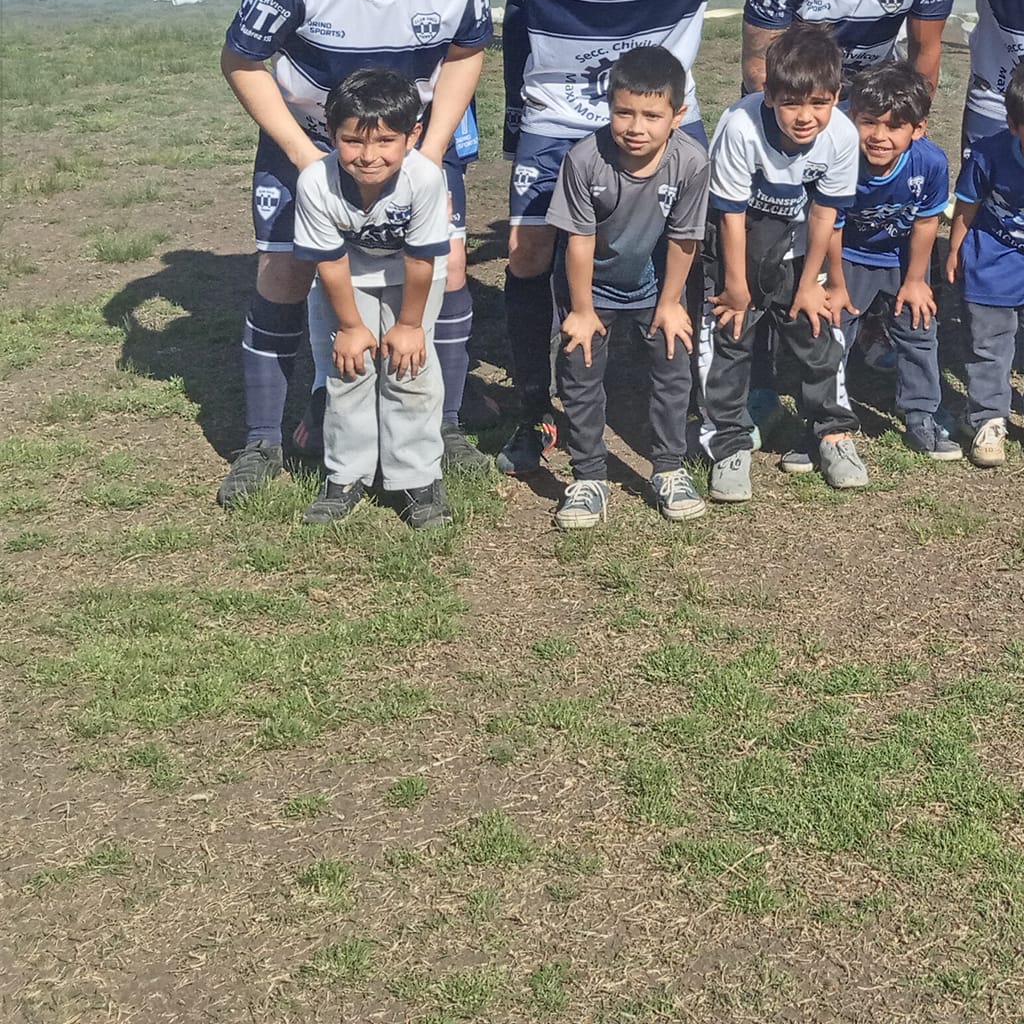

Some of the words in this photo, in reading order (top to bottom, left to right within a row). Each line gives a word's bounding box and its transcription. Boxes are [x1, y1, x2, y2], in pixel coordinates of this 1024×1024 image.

[310, 27, 341, 38] SPORTS
[575, 47, 609, 64] Secc.
[565, 73, 577, 103] Maxi
